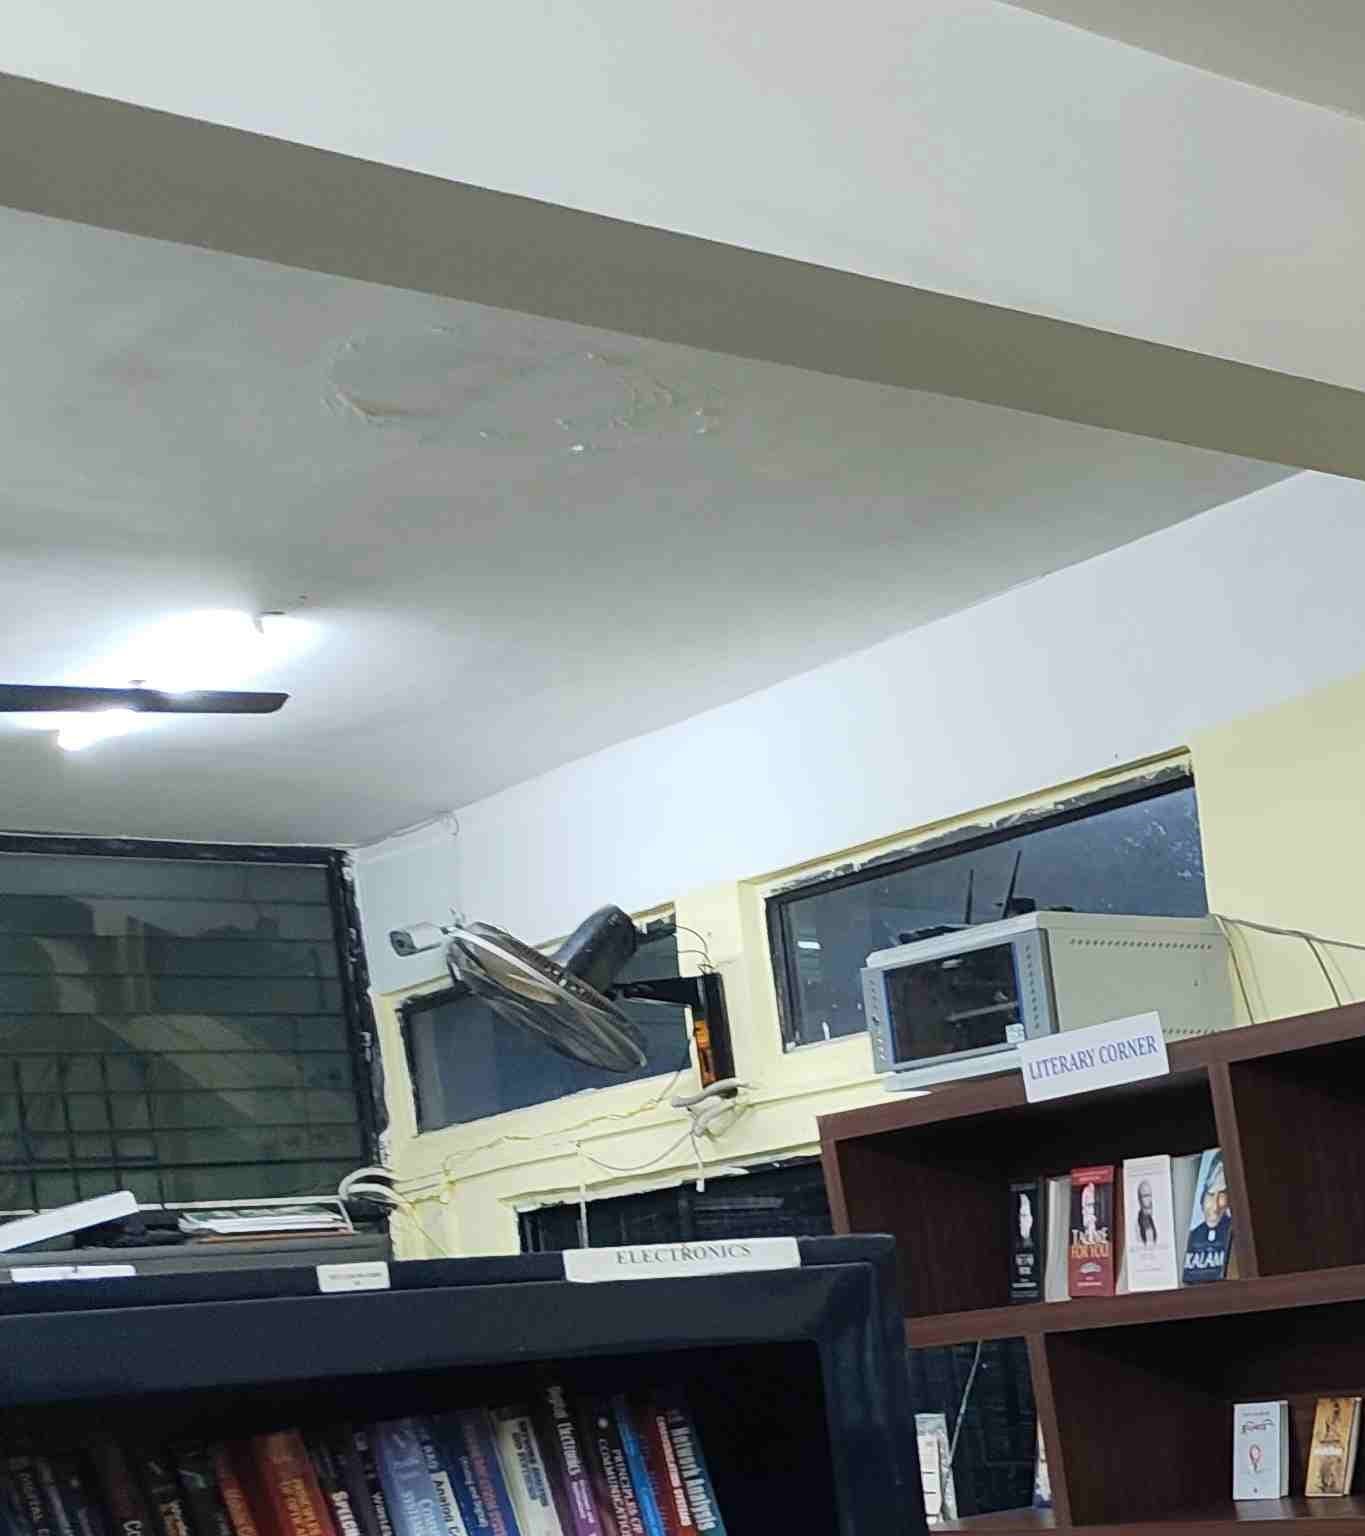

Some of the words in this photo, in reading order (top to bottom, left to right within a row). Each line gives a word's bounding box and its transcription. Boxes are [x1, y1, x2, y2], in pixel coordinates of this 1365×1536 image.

[1028, 1048, 1097, 1081] LITERARY
[1100, 1035, 1159, 1064] CORNER
[615, 1242, 753, 1266] ELECTRONICS
[669, 1425, 703, 1479] Network
[431, 1478, 457, 1523] Analog
[685, 1476, 718, 1532] Analysis
